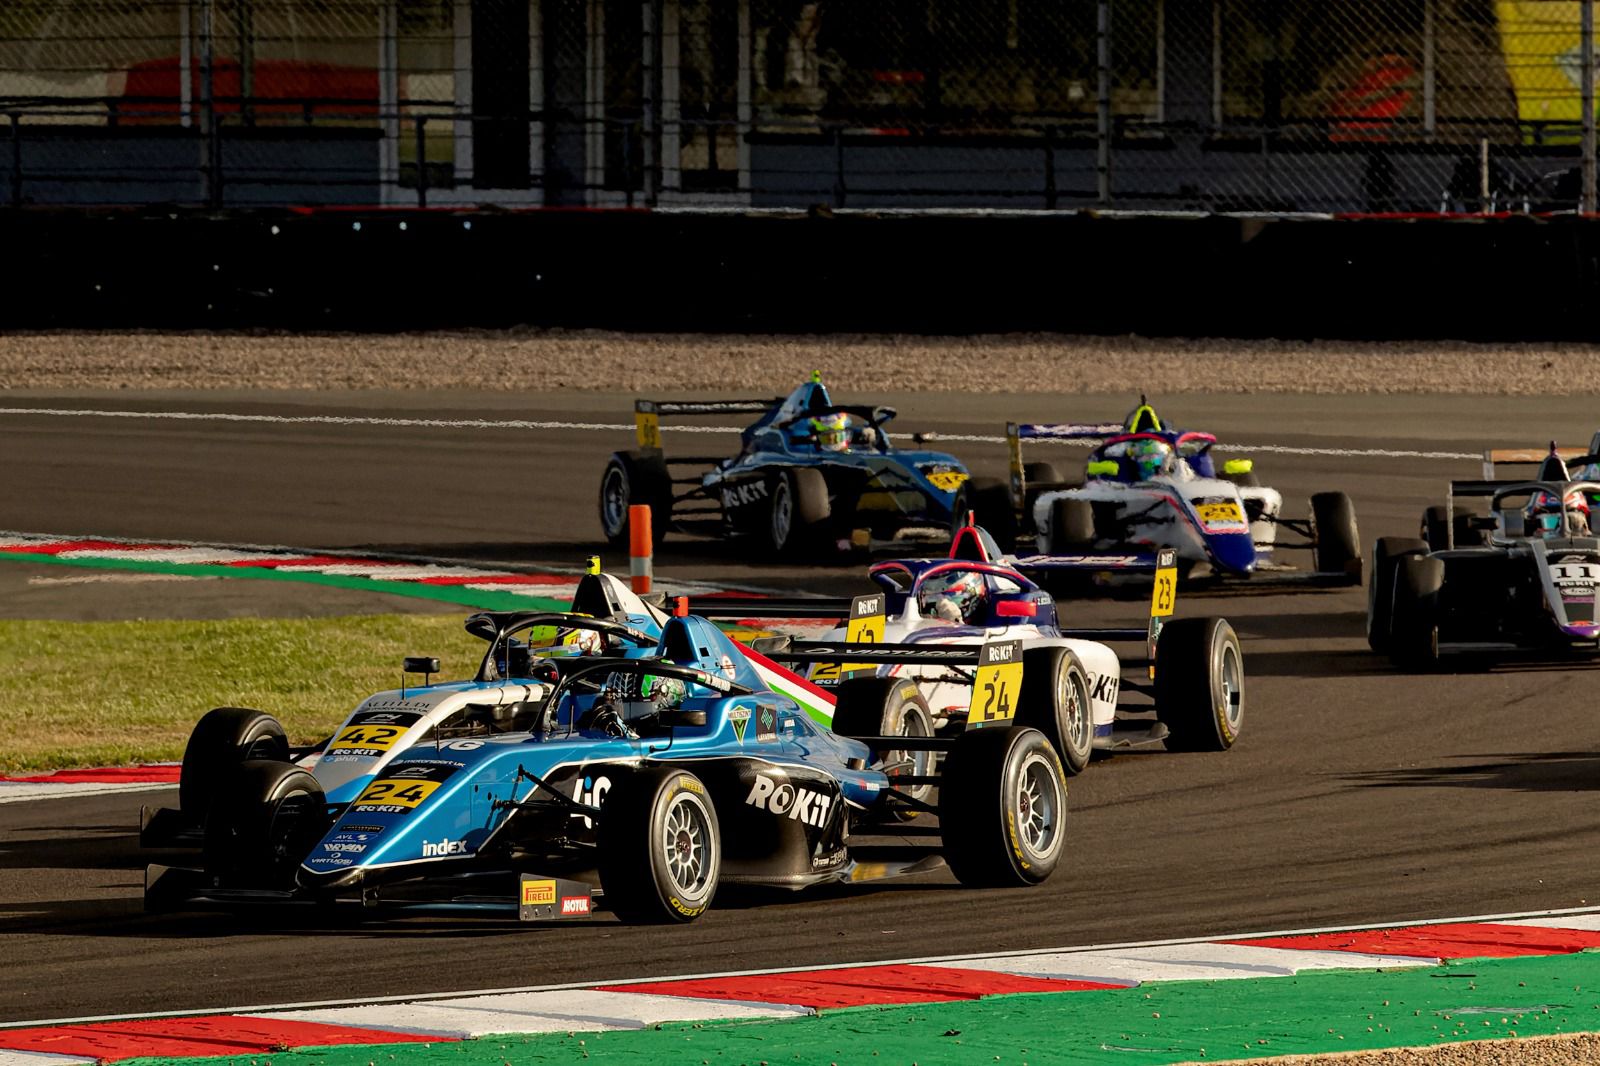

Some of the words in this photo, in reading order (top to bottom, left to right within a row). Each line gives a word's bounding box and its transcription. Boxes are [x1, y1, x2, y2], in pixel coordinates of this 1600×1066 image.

[1555, 567, 1595, 578] 11
[1158, 578, 1171, 610] 23
[984, 682, 1009, 720] 24
[338, 728, 398, 745] 42
[360, 783, 424, 802] 24
[745, 774, 831, 829] ROKiT
[525, 886, 553, 902] PIRELLI
[562, 899, 589, 912] MOTUL
